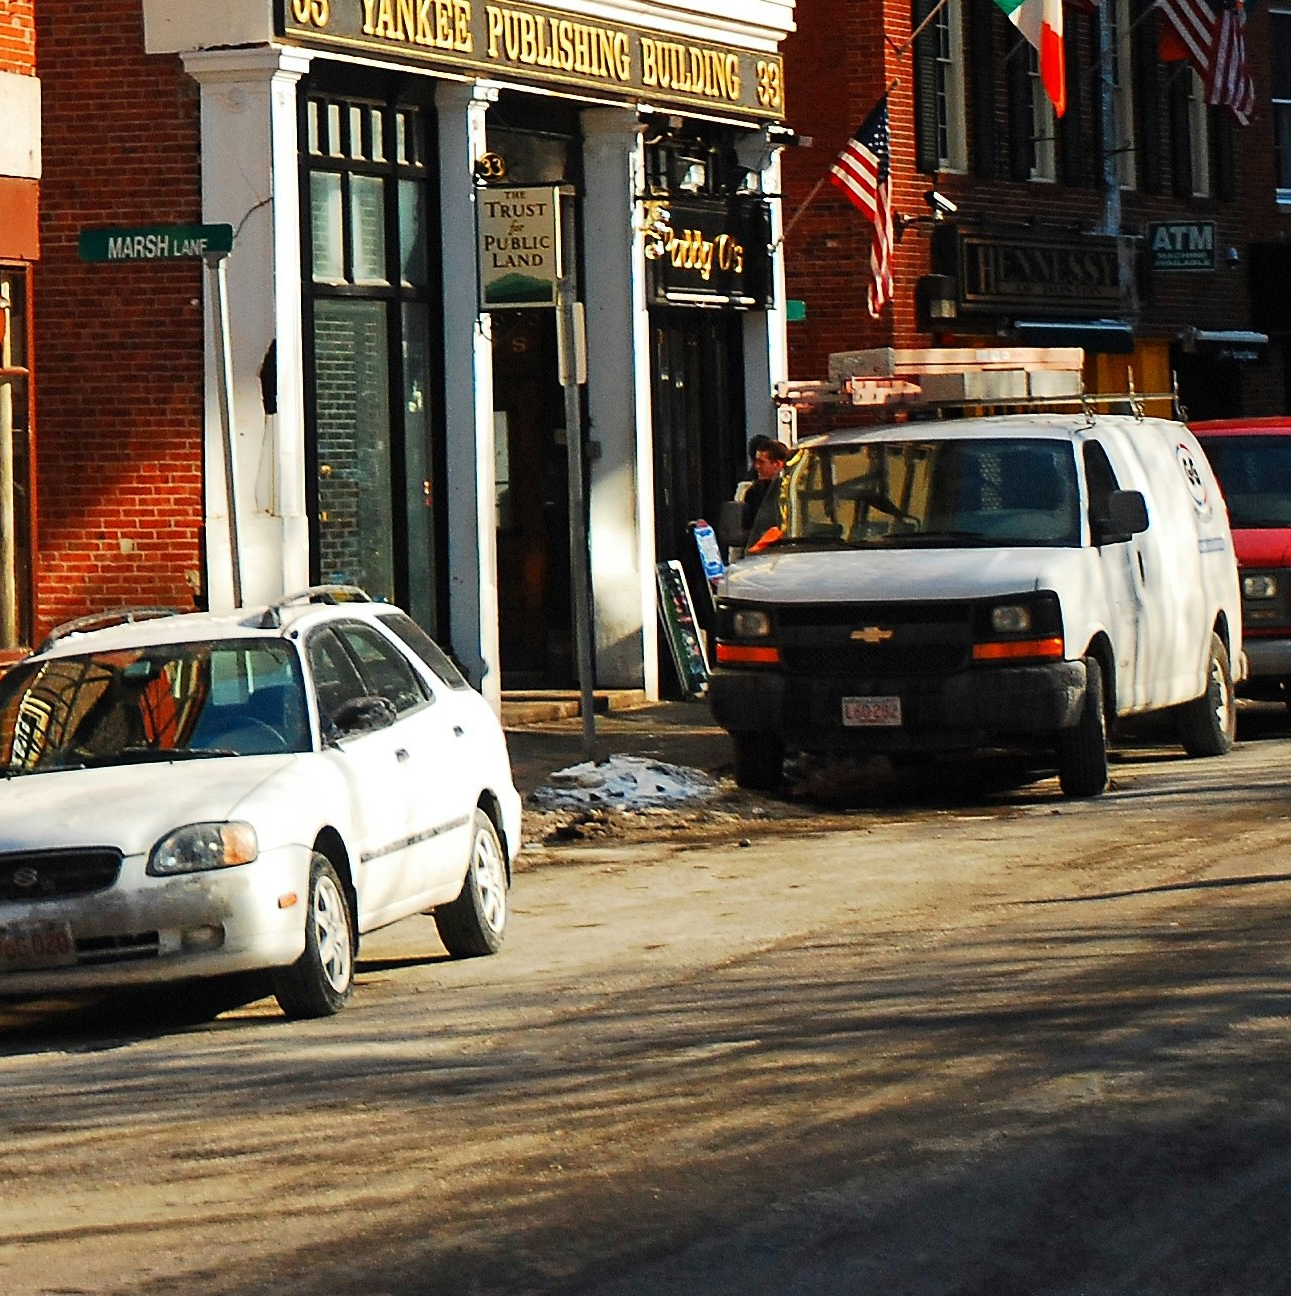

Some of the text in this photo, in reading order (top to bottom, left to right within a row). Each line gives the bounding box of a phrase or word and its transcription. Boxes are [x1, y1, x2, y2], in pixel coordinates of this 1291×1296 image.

[486, 5, 631, 82] PUBLISHING
[641, 36, 741, 101] BUILDING
[756, 60, 781, 107] 33
[481, 157, 504, 177] 33
[504, 191, 526, 199] THE
[484, 201, 547, 218] TRUST
[508, 219, 524, 235] for
[484, 235, 550, 251] PUBLIC
[1152, 226, 1213, 250] ATM
[107, 235, 208, 260] MARSH LANE
[493, 253, 544, 268] LAND
